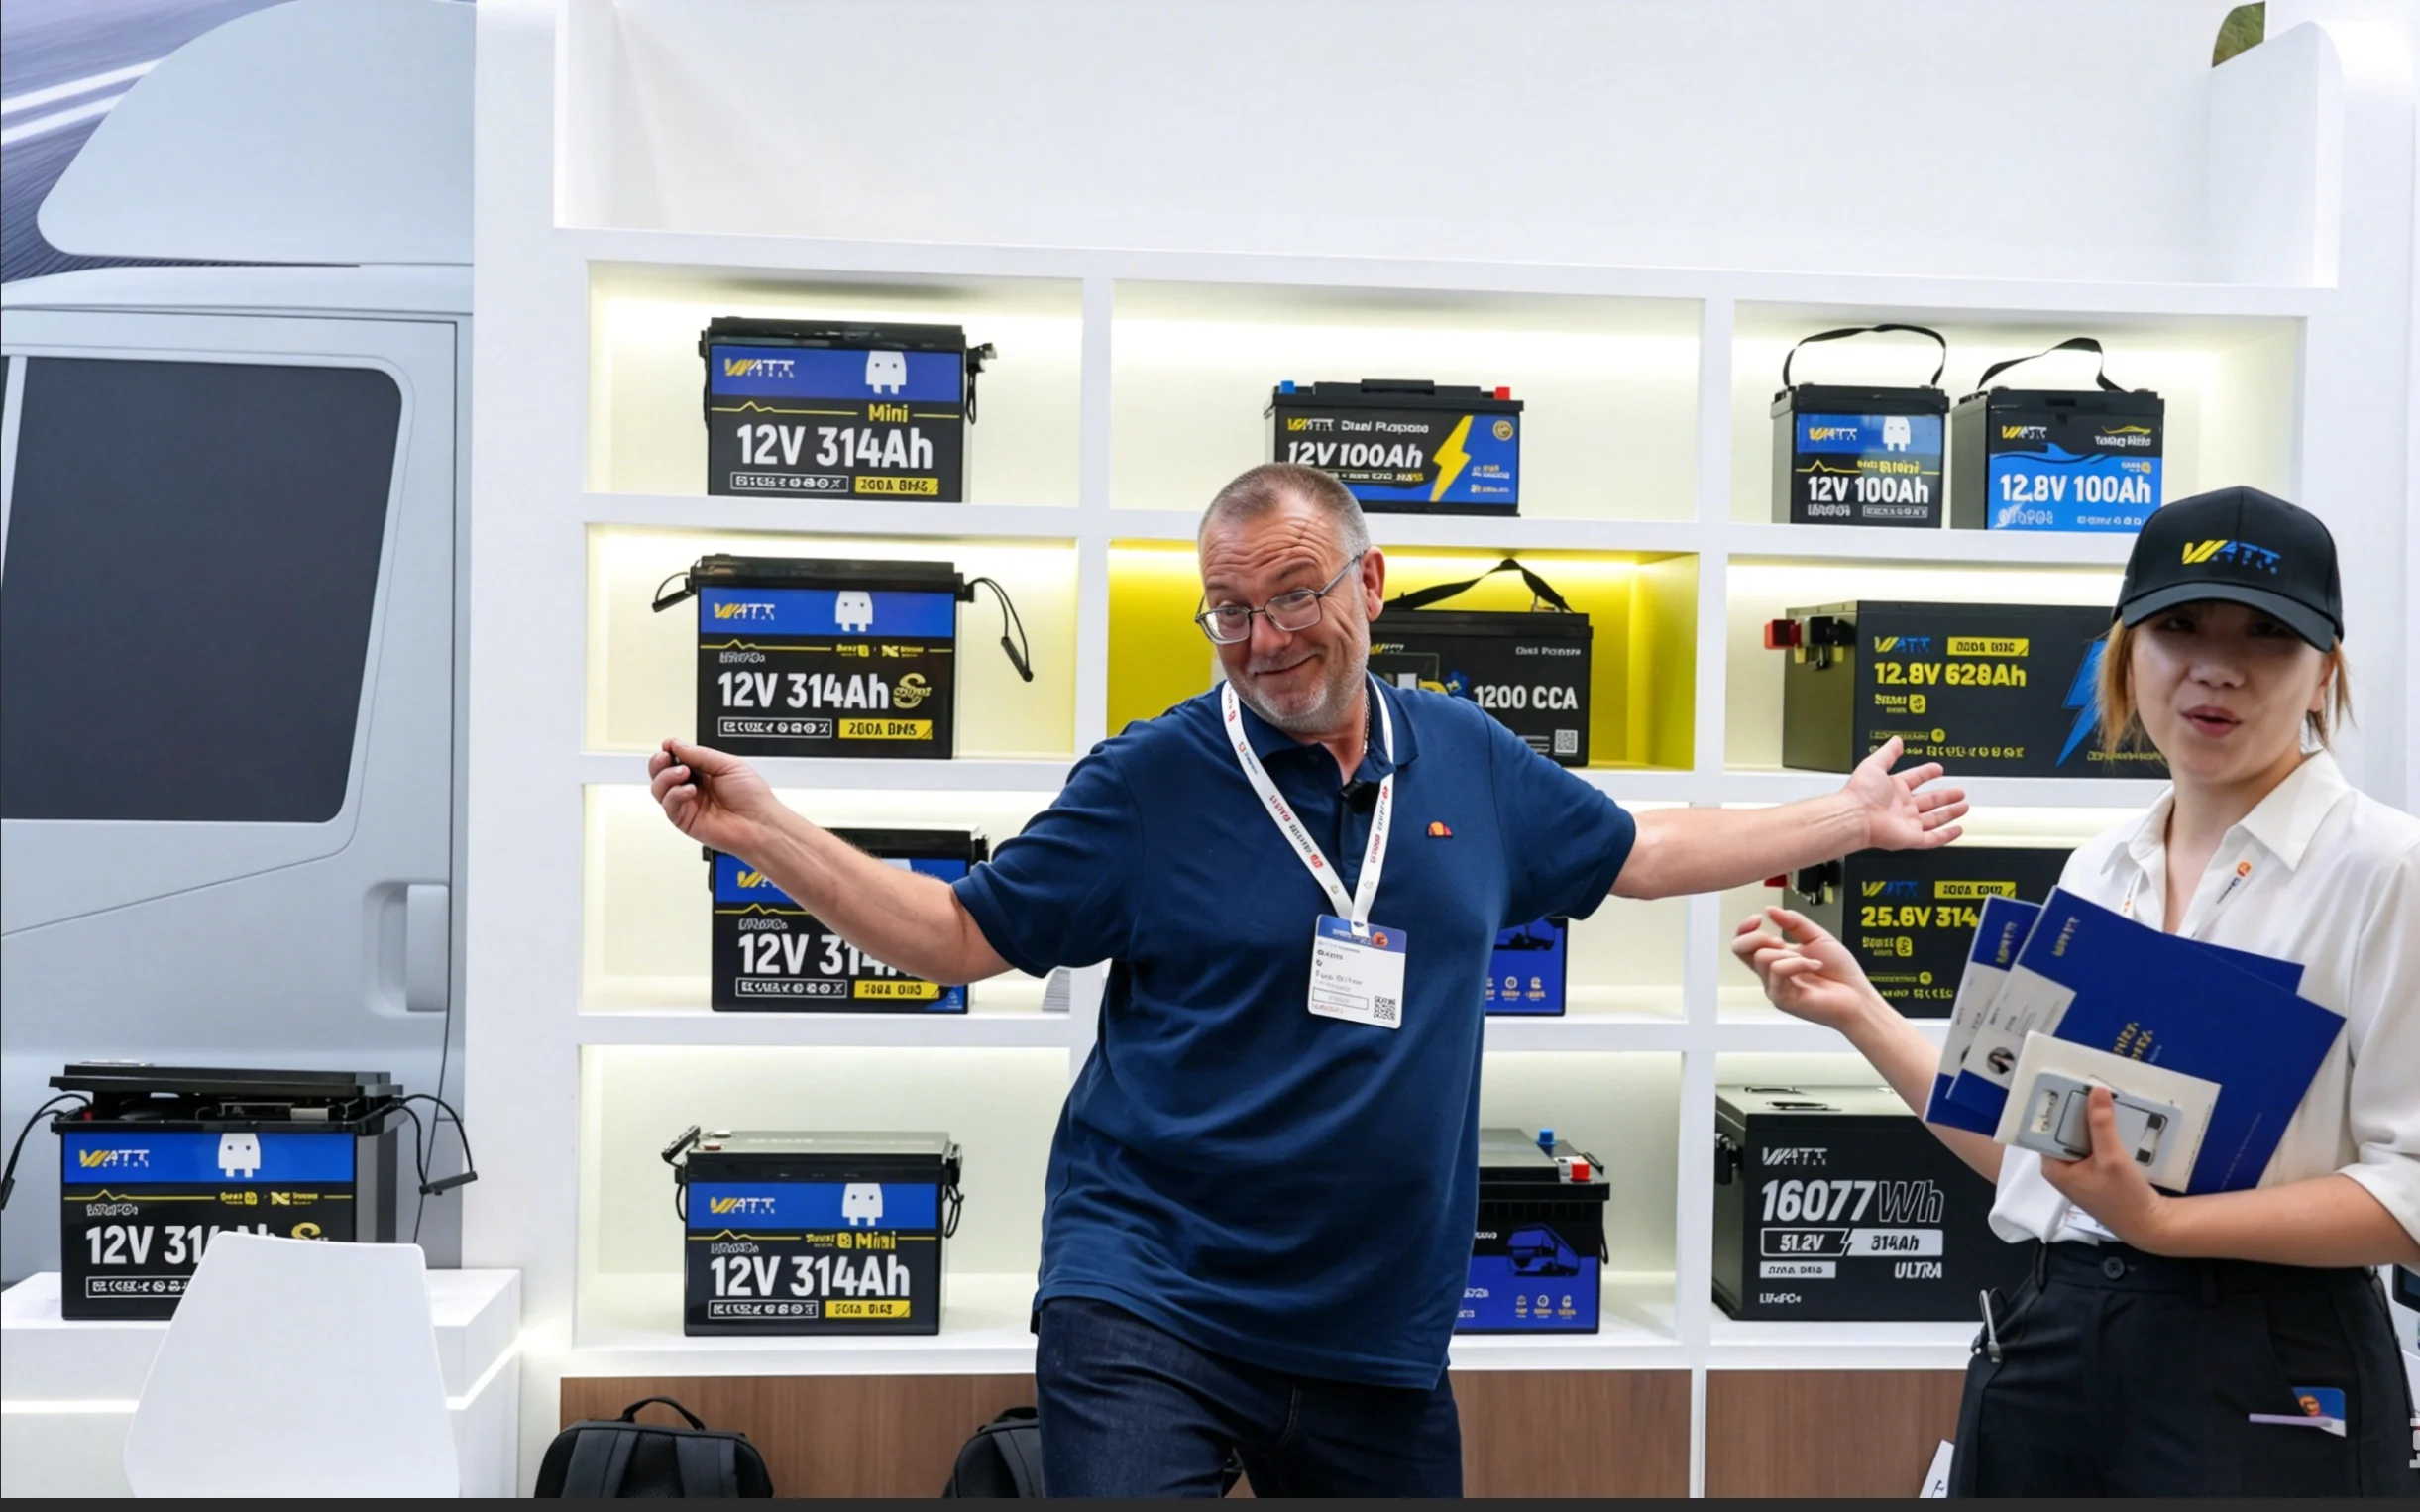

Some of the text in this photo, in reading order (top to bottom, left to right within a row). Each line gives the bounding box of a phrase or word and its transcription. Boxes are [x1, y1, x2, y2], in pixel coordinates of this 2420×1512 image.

[724, 358, 795, 378] WATT
[868, 403, 909, 423] Mini
[736, 424, 934, 469] 12V 314Ah
[1287, 441, 1424, 469] 12V 100Ah
[1808, 476, 1929, 504] 12V 100Ah
[1999, 474, 2151, 504] 12.8V 100Ah
[1874, 662, 2027, 687] 12.8V 628Ah
[718, 671, 779, 708] 12V
[786, 673, 890, 709] 314Ah
[1474, 685, 1579, 709] 1200 CCA
[1860, 906, 1932, 928] 25.6V
[738, 933, 810, 975] 12V
[1761, 1179, 1945, 1223] 16077Wh
[85, 1224, 155, 1265] 12V
[855, 1231, 897, 1250] Mini
[710, 1254, 911, 1298] 12V 314Ah
[1895, 1261, 1943, 1279] ULTRA
